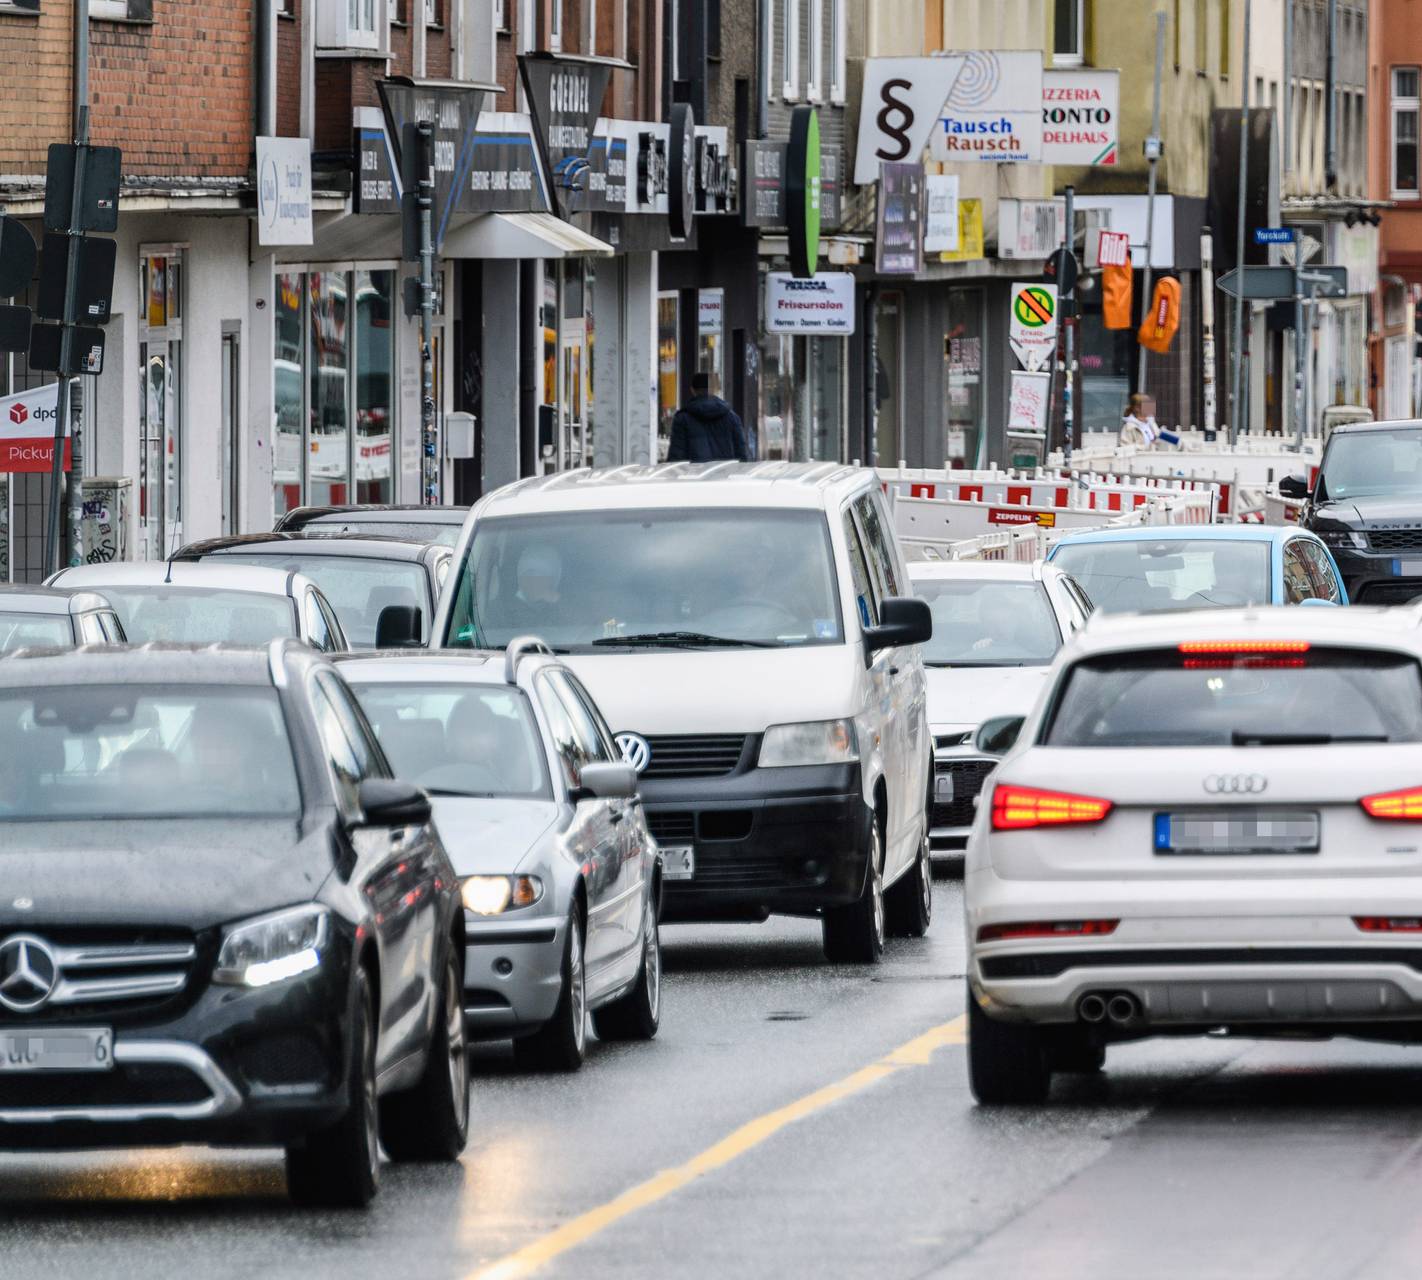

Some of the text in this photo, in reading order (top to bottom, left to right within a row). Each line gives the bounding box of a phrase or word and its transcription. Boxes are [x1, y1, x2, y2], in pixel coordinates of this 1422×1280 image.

[550, 73, 590, 113] GOERDEL
[942, 117, 1013, 134] Tausch
[946, 135, 1021, 151] Rausch
[979, 153, 1030, 161] second hand
[777, 299, 844, 310] Friseursalon
[33, 407, 58, 422] dpd
[995, 513, 1032, 521] ZEPPELIN
